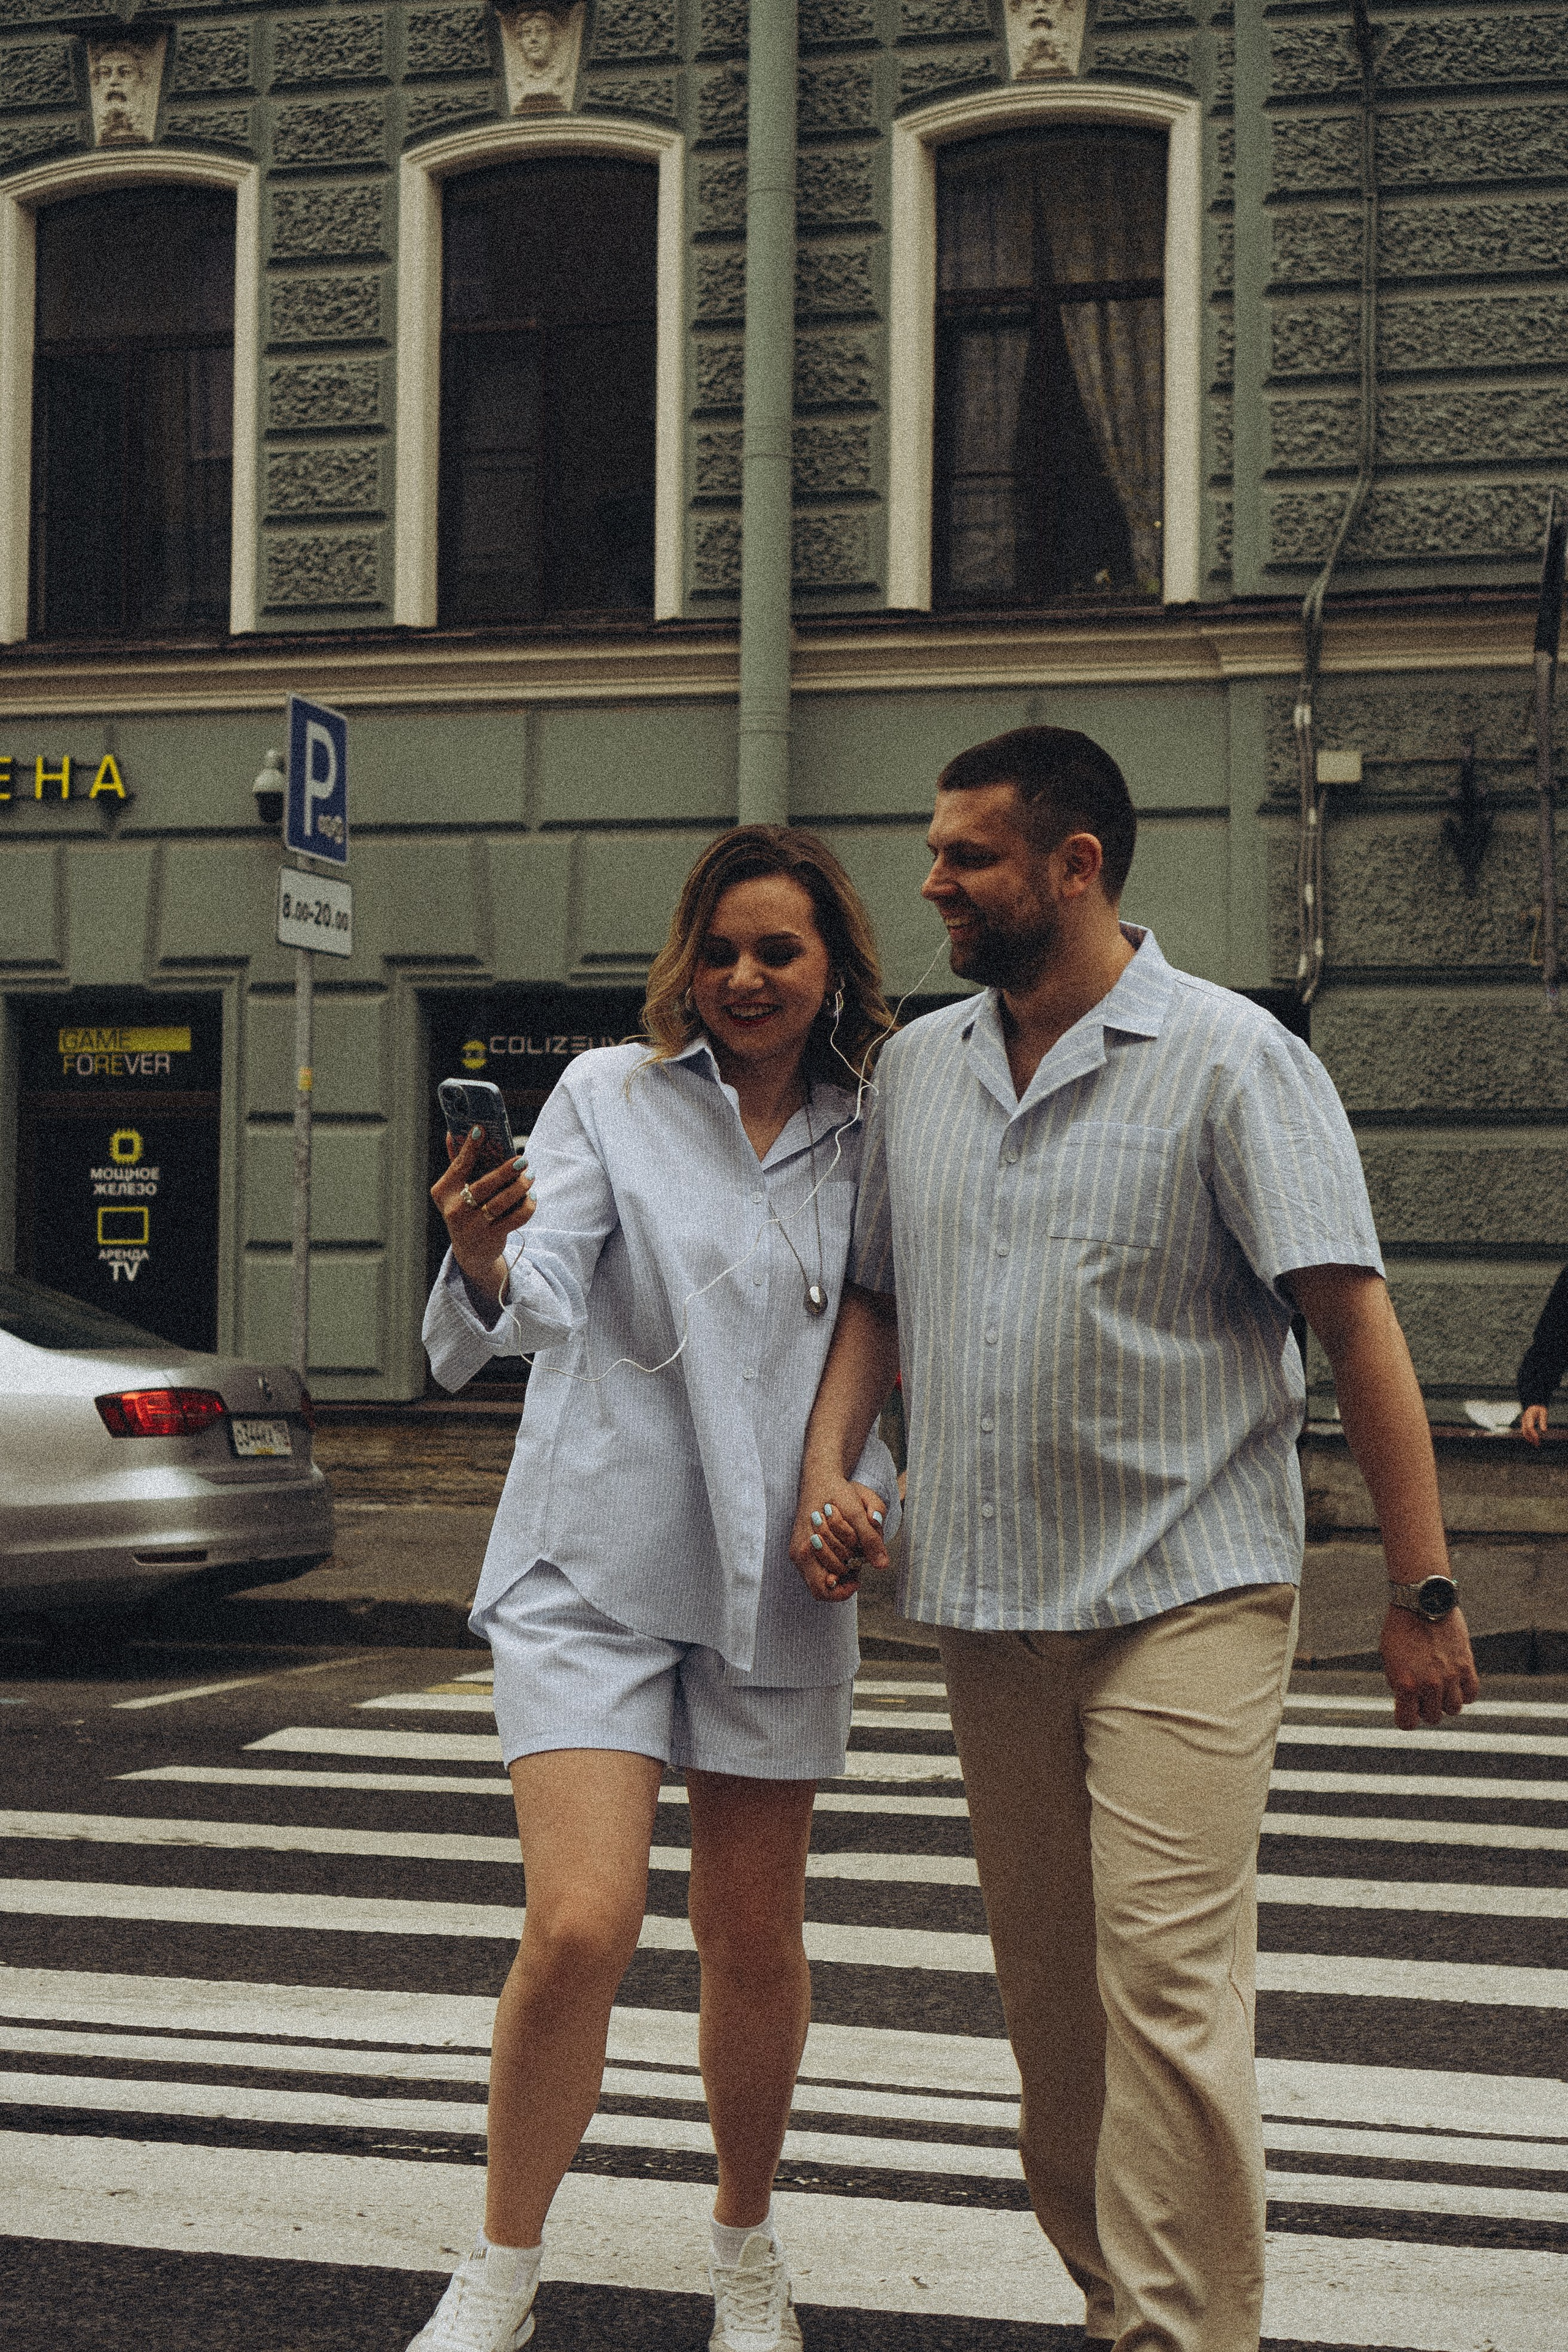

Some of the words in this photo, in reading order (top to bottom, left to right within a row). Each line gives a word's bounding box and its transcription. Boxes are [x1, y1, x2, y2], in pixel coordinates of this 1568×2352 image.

[304, 720, 337, 836] P
[62, 1027, 132, 1050] GAME
[62, 1053, 171, 1076] FOREVER
[90, 1167, 160, 1182] МОЩНОЕ
[93, 1182, 158, 1196] ЖЕЛЕЗО
[98, 1248, 149, 1262] АРЕНДА
[108, 1261, 140, 1281] TV
